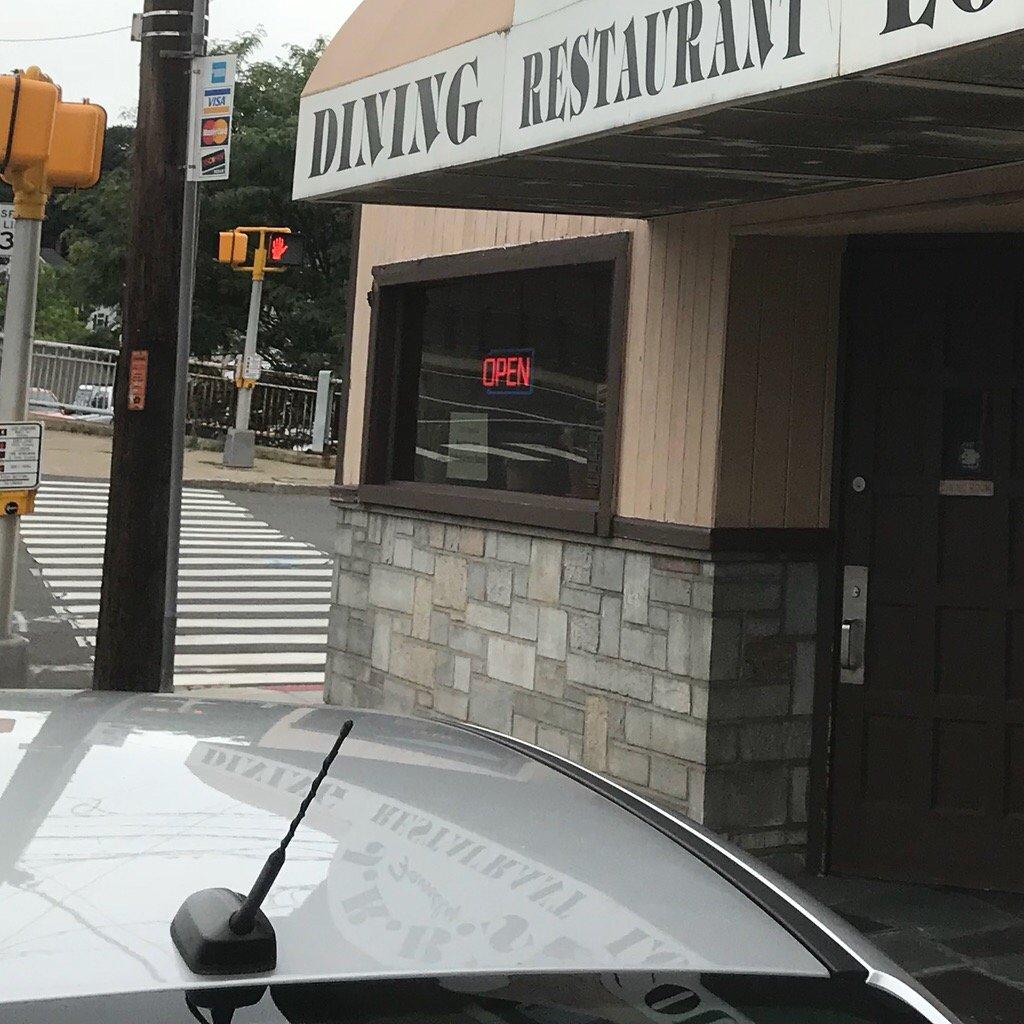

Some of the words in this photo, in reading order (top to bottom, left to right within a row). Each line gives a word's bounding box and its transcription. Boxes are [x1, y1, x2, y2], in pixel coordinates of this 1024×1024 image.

[208, 96, 226, 107] VISA
[308, 56, 484, 180] DINING
[482, 357, 531, 387] OPEN
